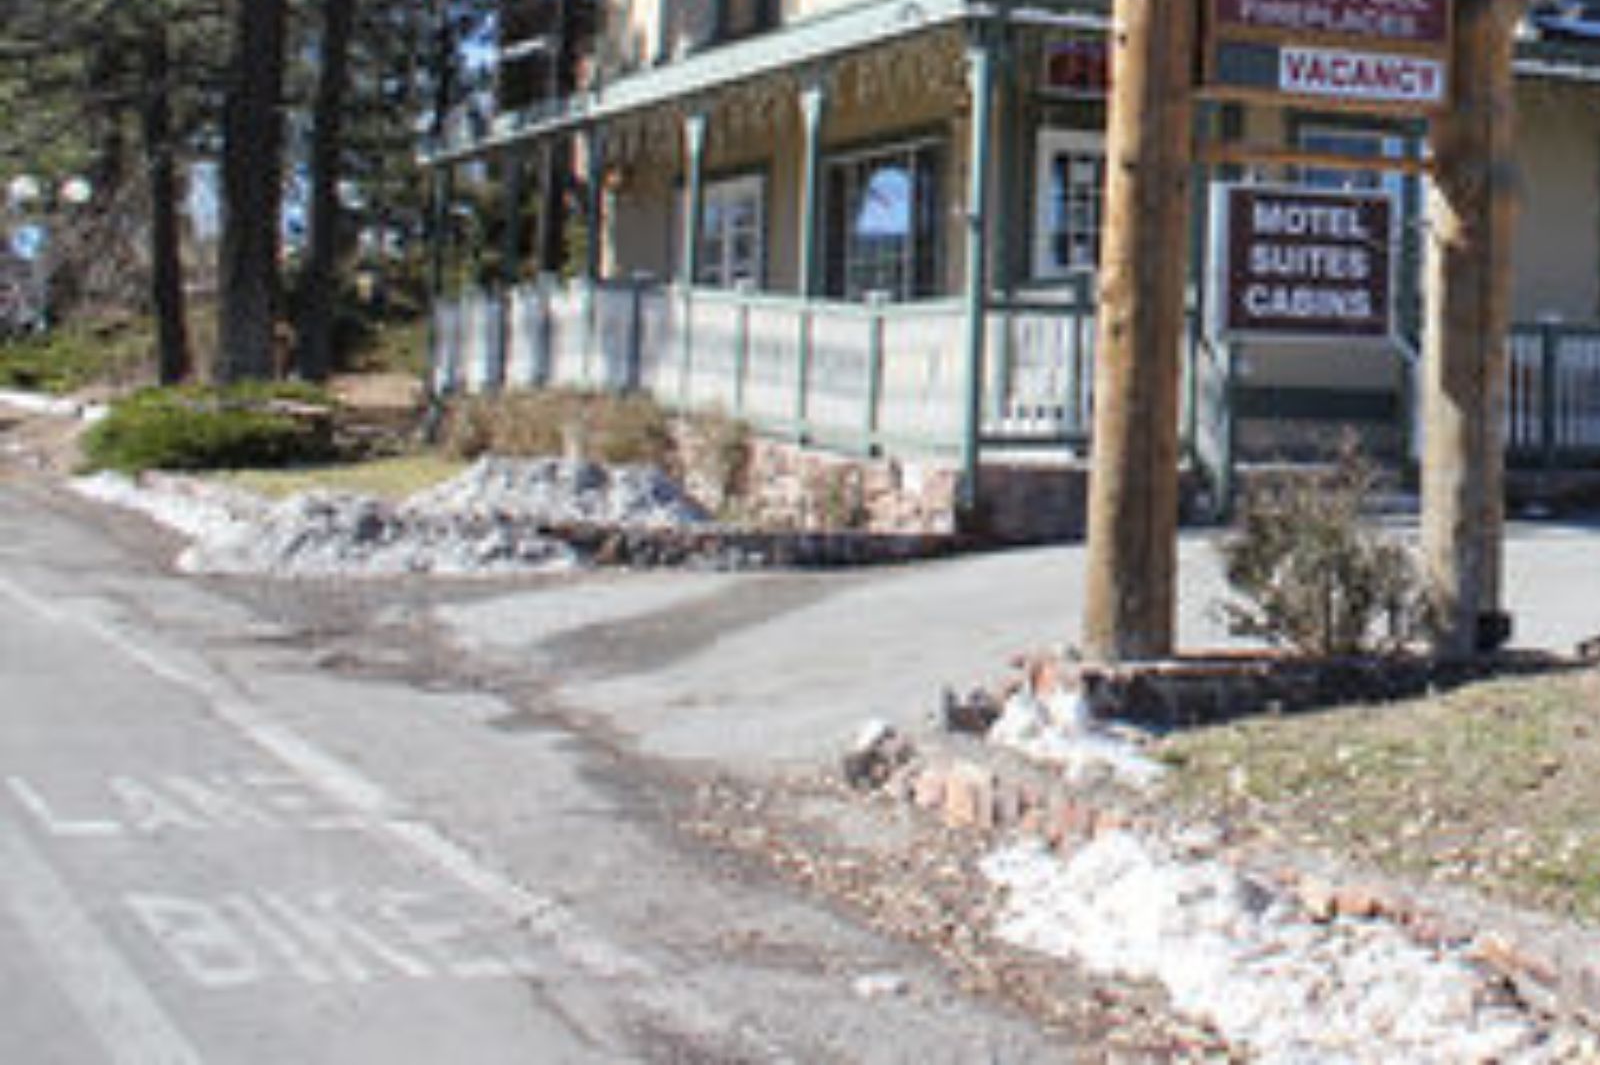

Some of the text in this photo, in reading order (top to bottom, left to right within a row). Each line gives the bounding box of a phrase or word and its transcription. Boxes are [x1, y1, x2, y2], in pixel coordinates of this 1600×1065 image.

[1285, 52, 1440, 93] VACANCY
[1254, 201, 1368, 237] MOTEL
[1250, 244, 1371, 279] SUITES
[1244, 285, 1373, 319] CABINS
[122, 887, 541, 986] BIKE
